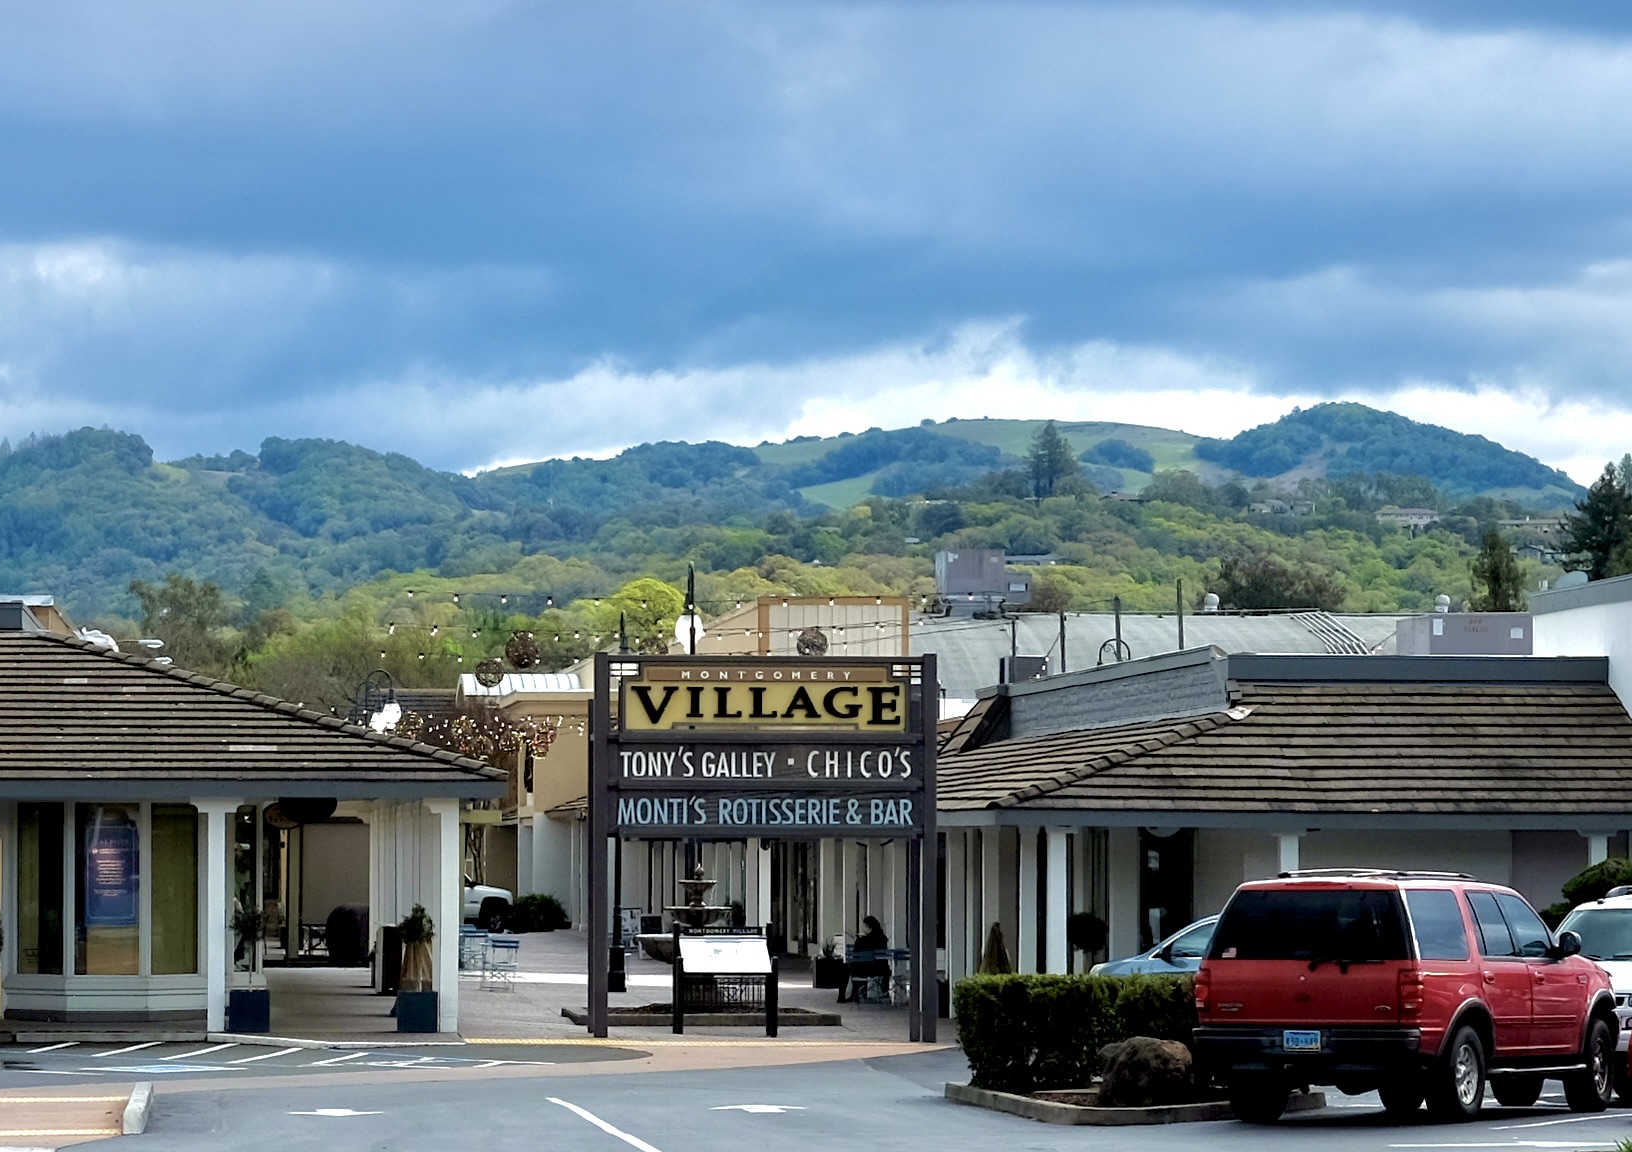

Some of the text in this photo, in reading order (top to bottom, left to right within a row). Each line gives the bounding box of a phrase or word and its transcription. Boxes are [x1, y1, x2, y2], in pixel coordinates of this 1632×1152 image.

[680, 670, 852, 681] MONTGOMERY
[630, 685, 901, 725] VILLAGE
[619, 745, 913, 779] TONY'S GALLEY CHICO'S
[617, 795, 914, 826] MONTI'S ROTISSERIE & BAR
